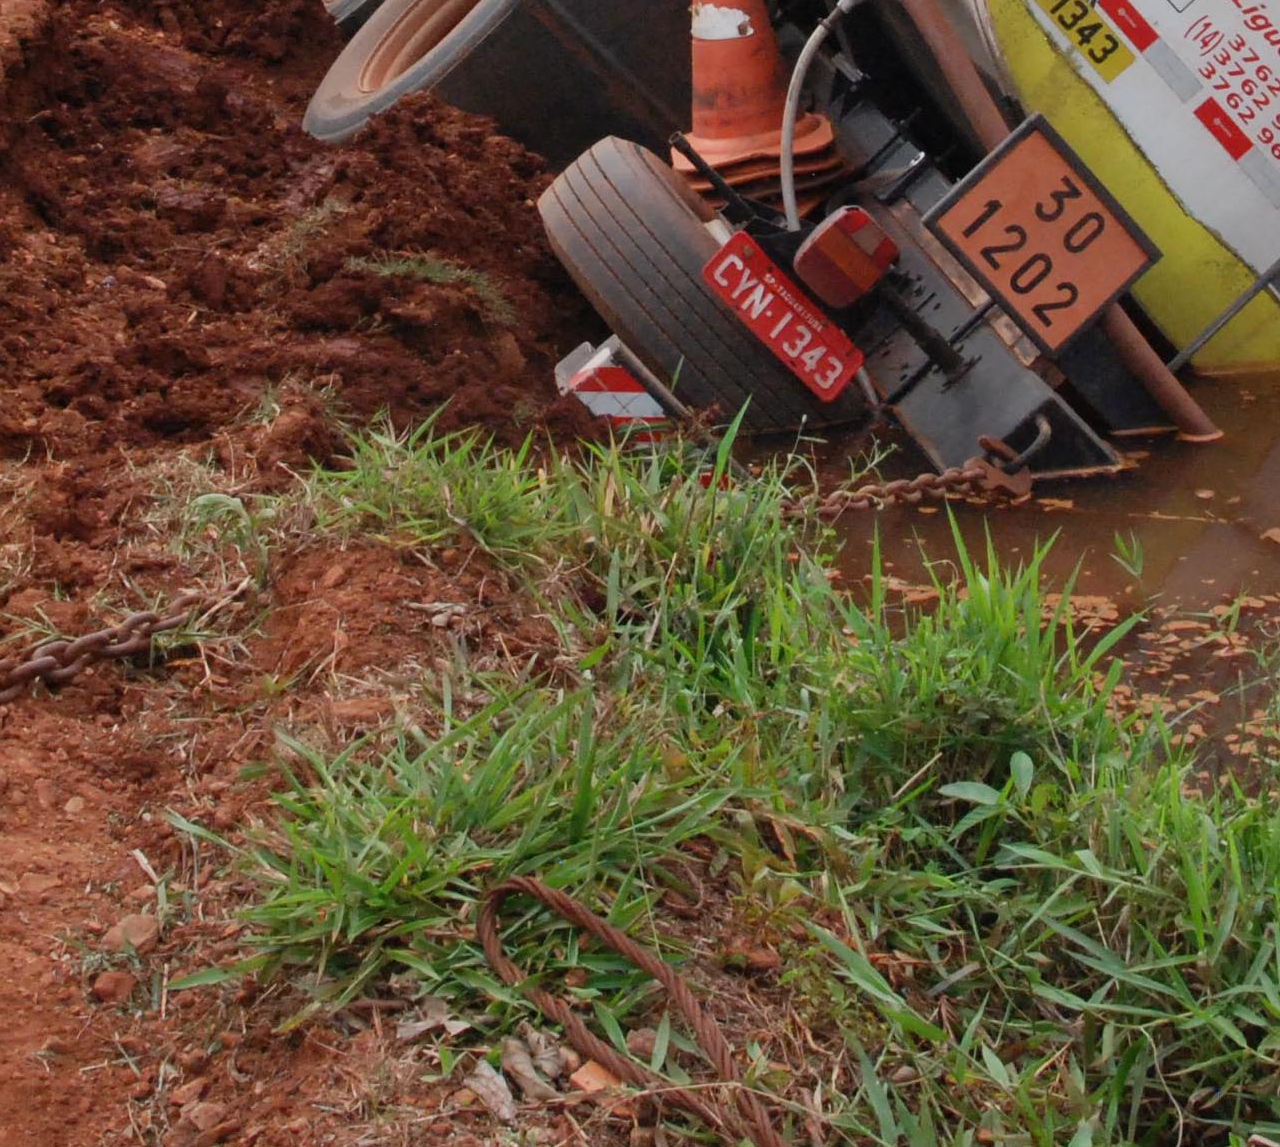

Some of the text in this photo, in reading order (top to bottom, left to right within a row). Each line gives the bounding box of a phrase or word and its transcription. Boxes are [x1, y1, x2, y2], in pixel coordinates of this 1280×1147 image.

[1184, 15, 1225, 56] (14)
[1199, 61, 1256, 125] 3762
[1214, 47, 1271, 112] 3762
[1034, 174, 1105, 254] 30
[962, 199, 1079, 328] 1202
